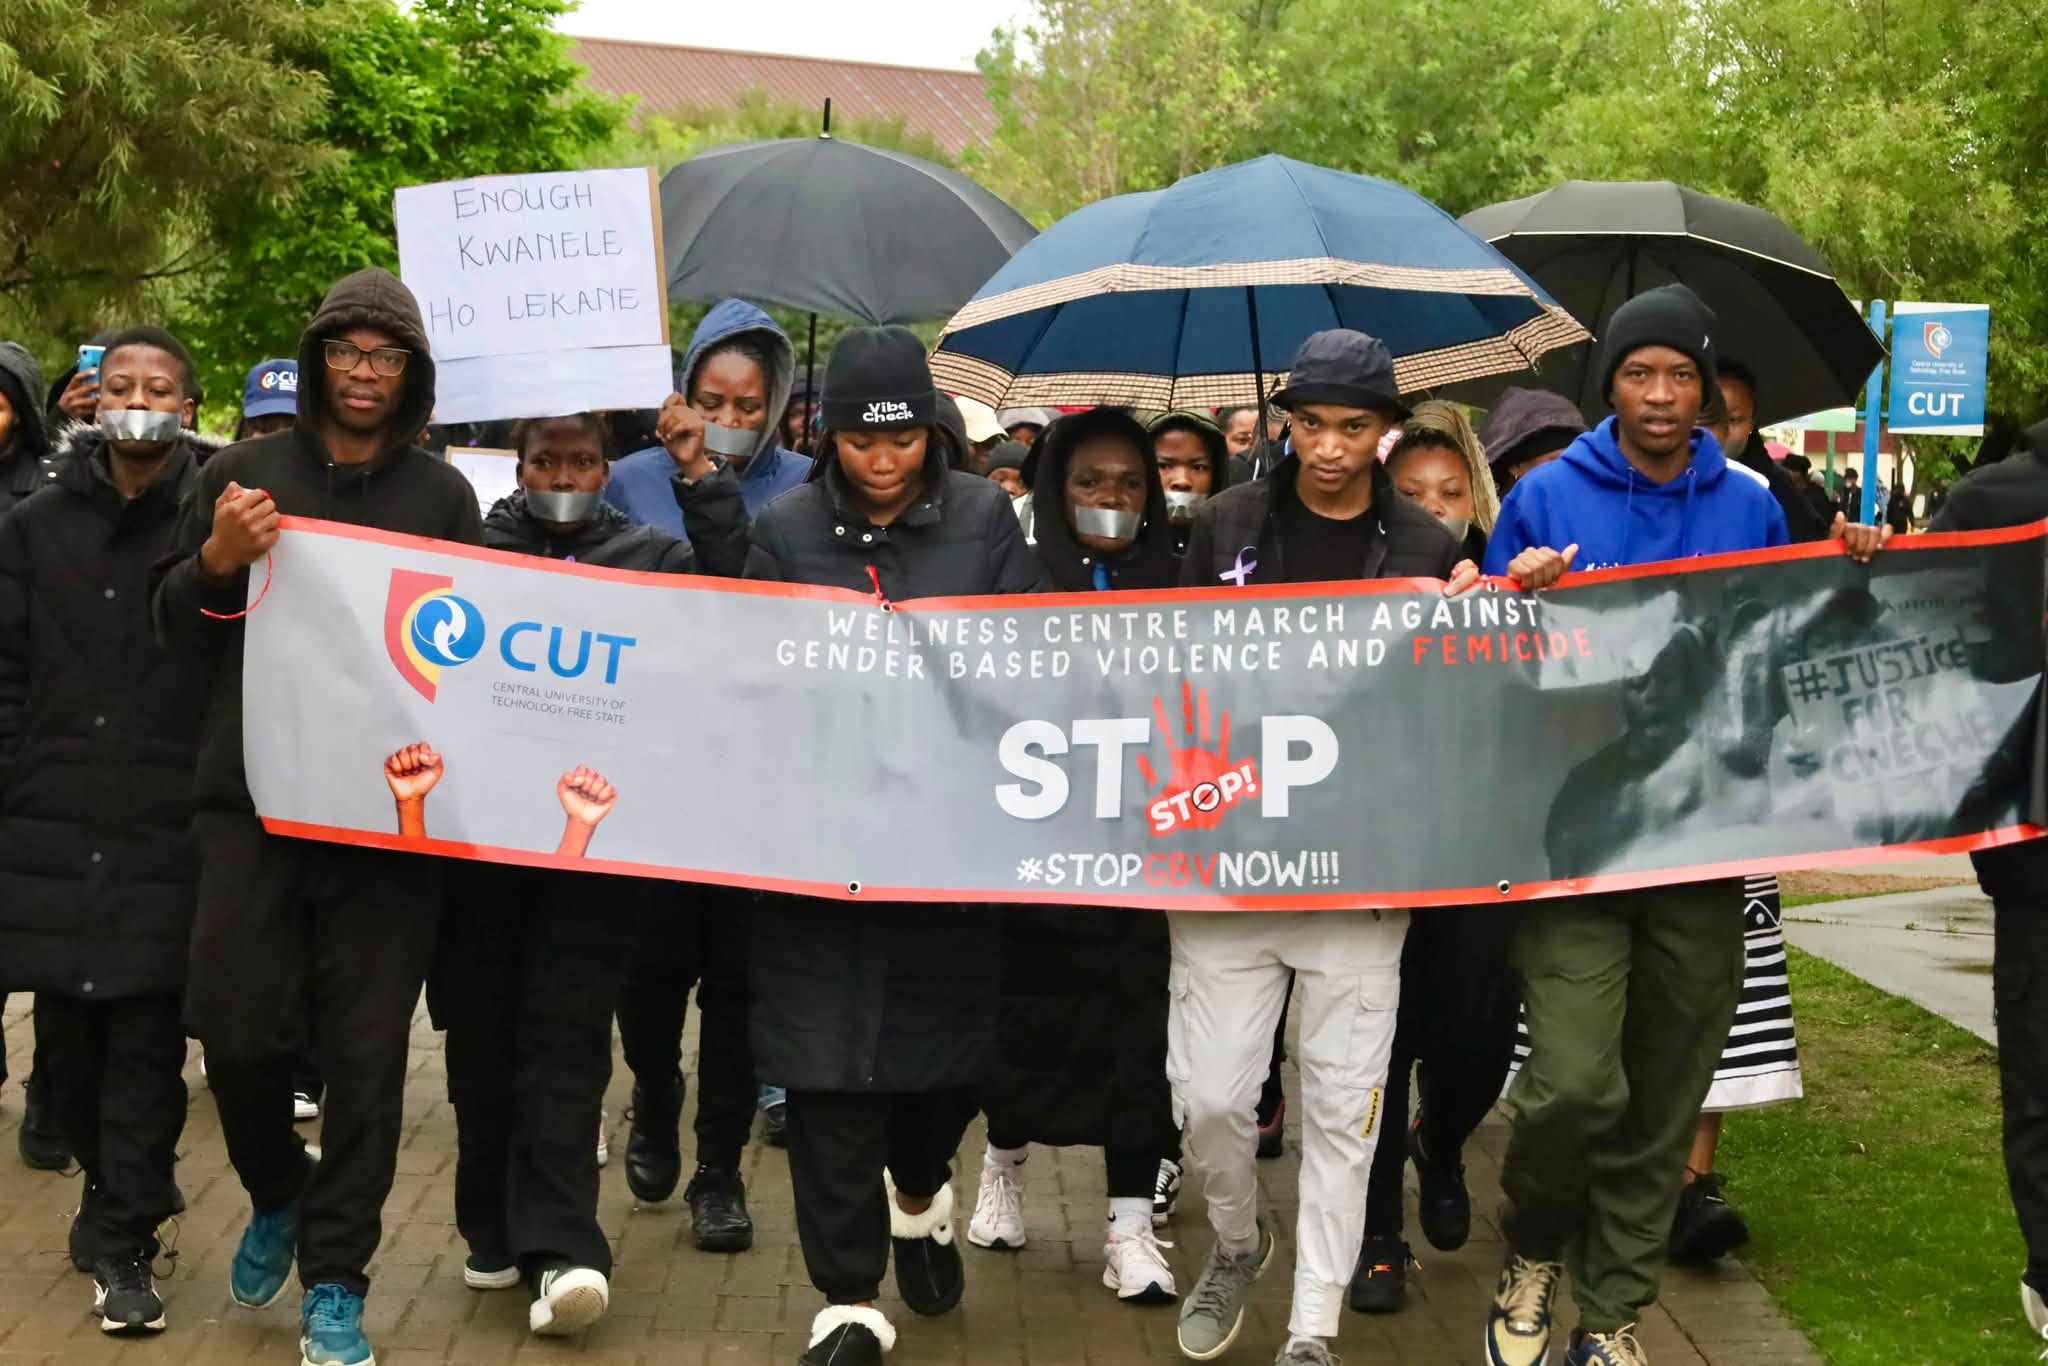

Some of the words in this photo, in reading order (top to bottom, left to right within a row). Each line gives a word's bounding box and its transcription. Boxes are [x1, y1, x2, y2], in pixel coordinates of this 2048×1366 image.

[453, 183, 593, 219] ENOUGH
[458, 230, 623, 270] KWANELE
[429, 297, 475, 334] HO
[507, 287, 640, 320] LEKANE
[862, 410, 914, 423] Check
[868, 401, 908, 413] Vibe
[1908, 391, 1965, 416] CUT
[827, 609, 1018, 647] WELLNESS
[1043, 609, 1188, 643] CENTRE
[1213, 603, 1345, 636] MARCH
[1371, 597, 1537, 631] AGAINST
[500, 621, 636, 684] CUT
[776, 640, 925, 680] GENDER
[949, 650, 1071, 680] BASED
[1097, 641, 1281, 676] VIOLENCE
[1306, 637, 1386, 670] AND
[1413, 627, 1592, 665] FEMICIDE
[492, 681, 542, 699] CENTRAL
[544, 689, 608, 708] UNIVERSITY
[610, 700, 627, 710] OF
[1842, 685, 1911, 729] FOR
[567, 706, 593, 721] FREE
[594, 711, 625, 725] STATE
[1150, 764, 1258, 832] STOP!
[1016, 850, 1341, 888] #STOPGBVNOW!!!
